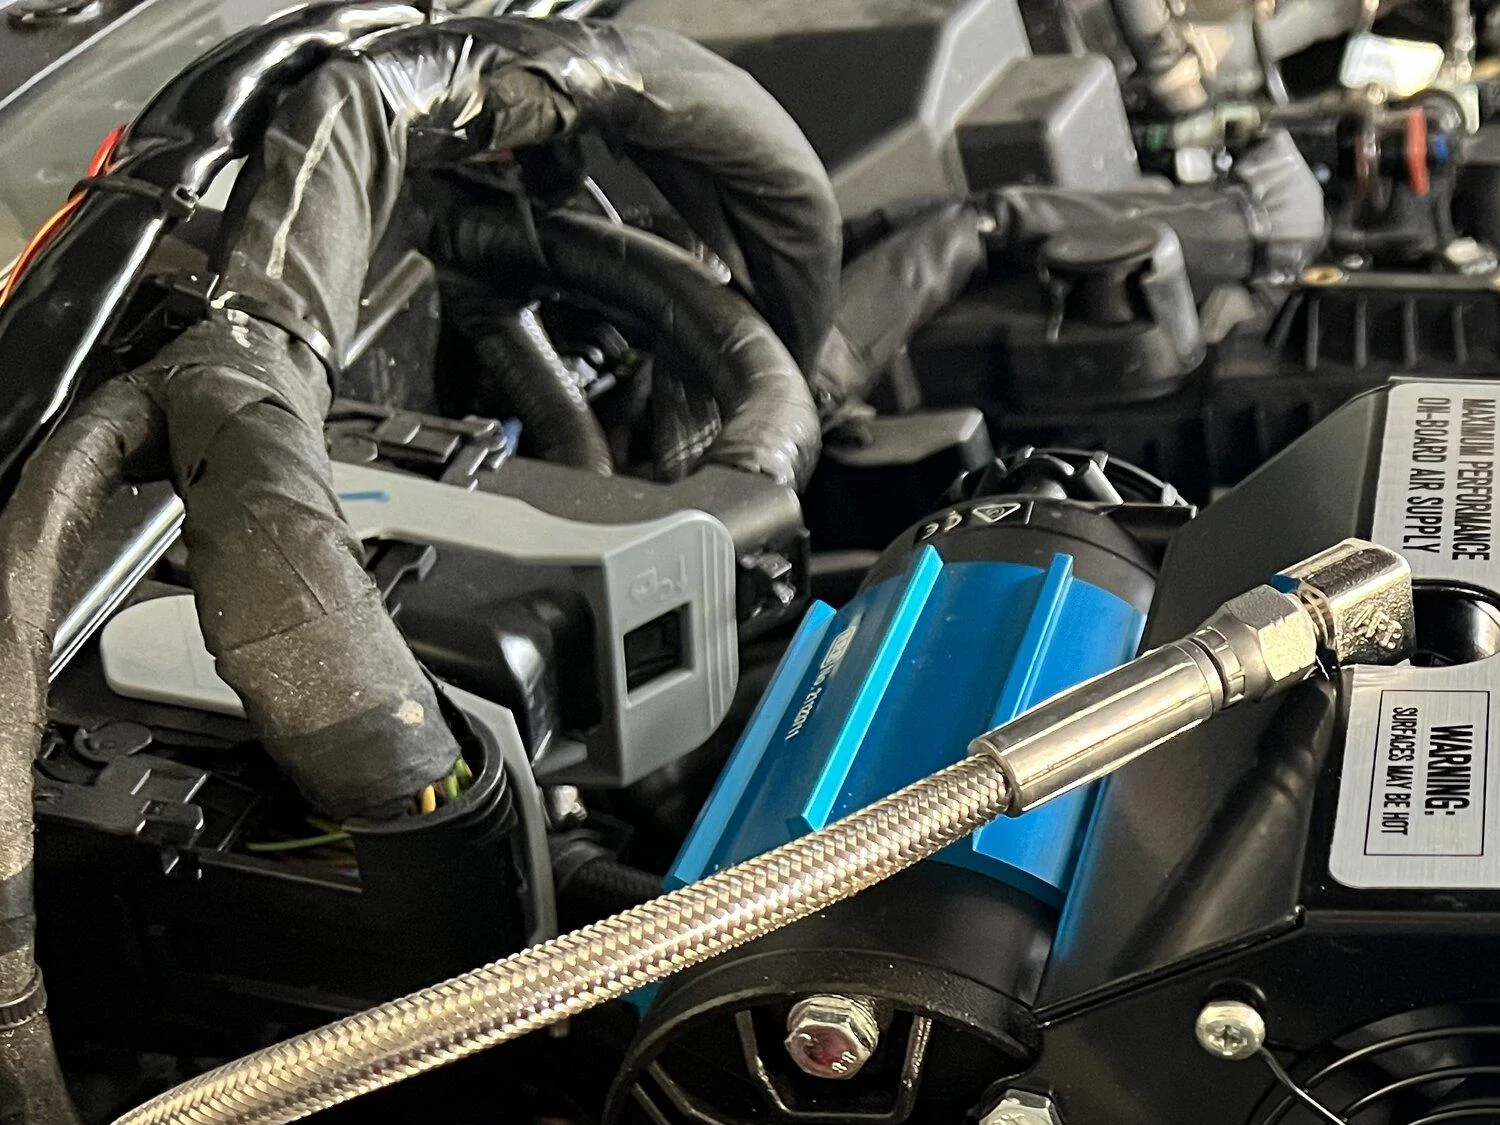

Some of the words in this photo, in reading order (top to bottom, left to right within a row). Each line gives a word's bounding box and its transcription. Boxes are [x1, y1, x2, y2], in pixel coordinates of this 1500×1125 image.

[1412, 398, 1451, 463] ON-BOARD
[1458, 399, 1496, 455] MAXIMUM
[1409, 468, 1445, 490] AIR
[1402, 497, 1443, 553] SUPPLY
[1451, 461, 1493, 560] PERFORMANCE
[1388, 707, 1419, 761] SURFACES
[1385, 766, 1413, 789] MAY
[1424, 725, 1472, 816] WARNING:
[1381, 812, 1408, 835] HOT
[1383, 793, 1410, 809] BE
